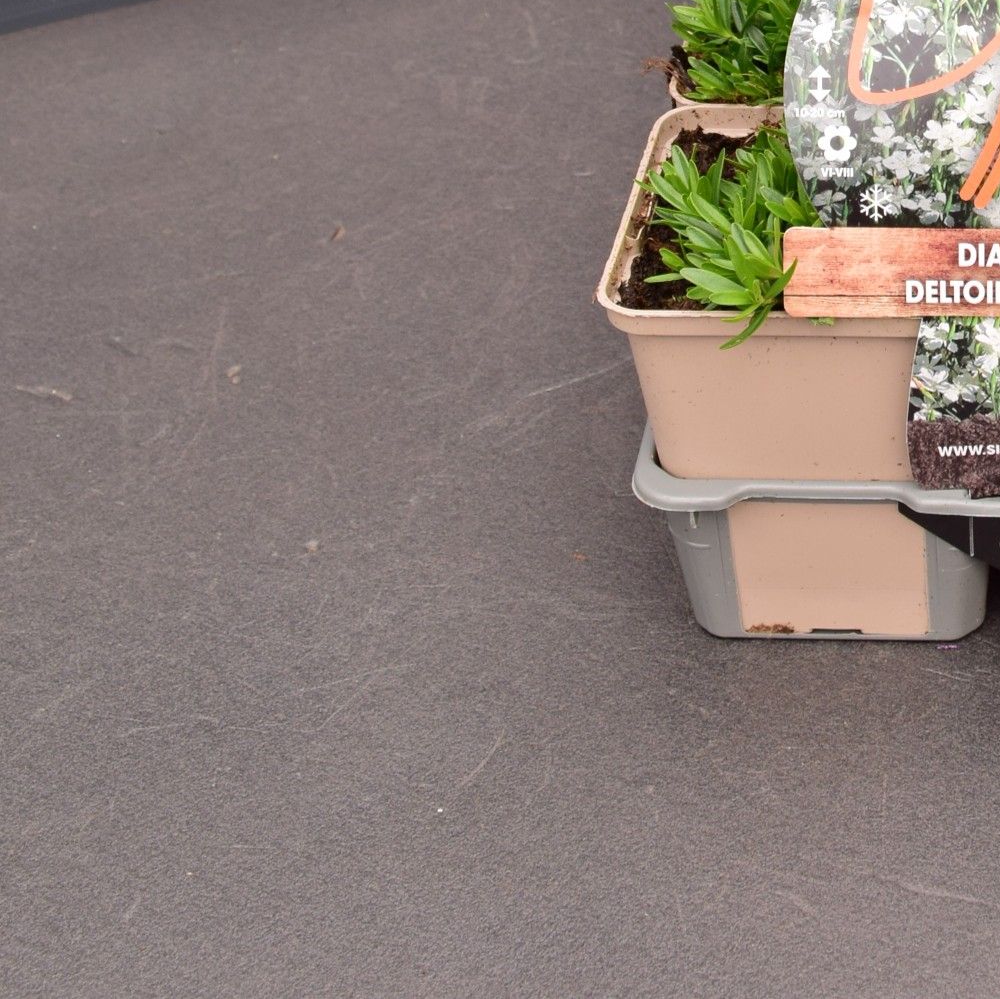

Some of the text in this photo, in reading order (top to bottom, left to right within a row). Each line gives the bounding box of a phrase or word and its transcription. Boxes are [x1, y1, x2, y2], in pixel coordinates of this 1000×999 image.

[793, 107, 846, 118] 10-20 cm
[820, 167, 854, 178] VI-VIII
